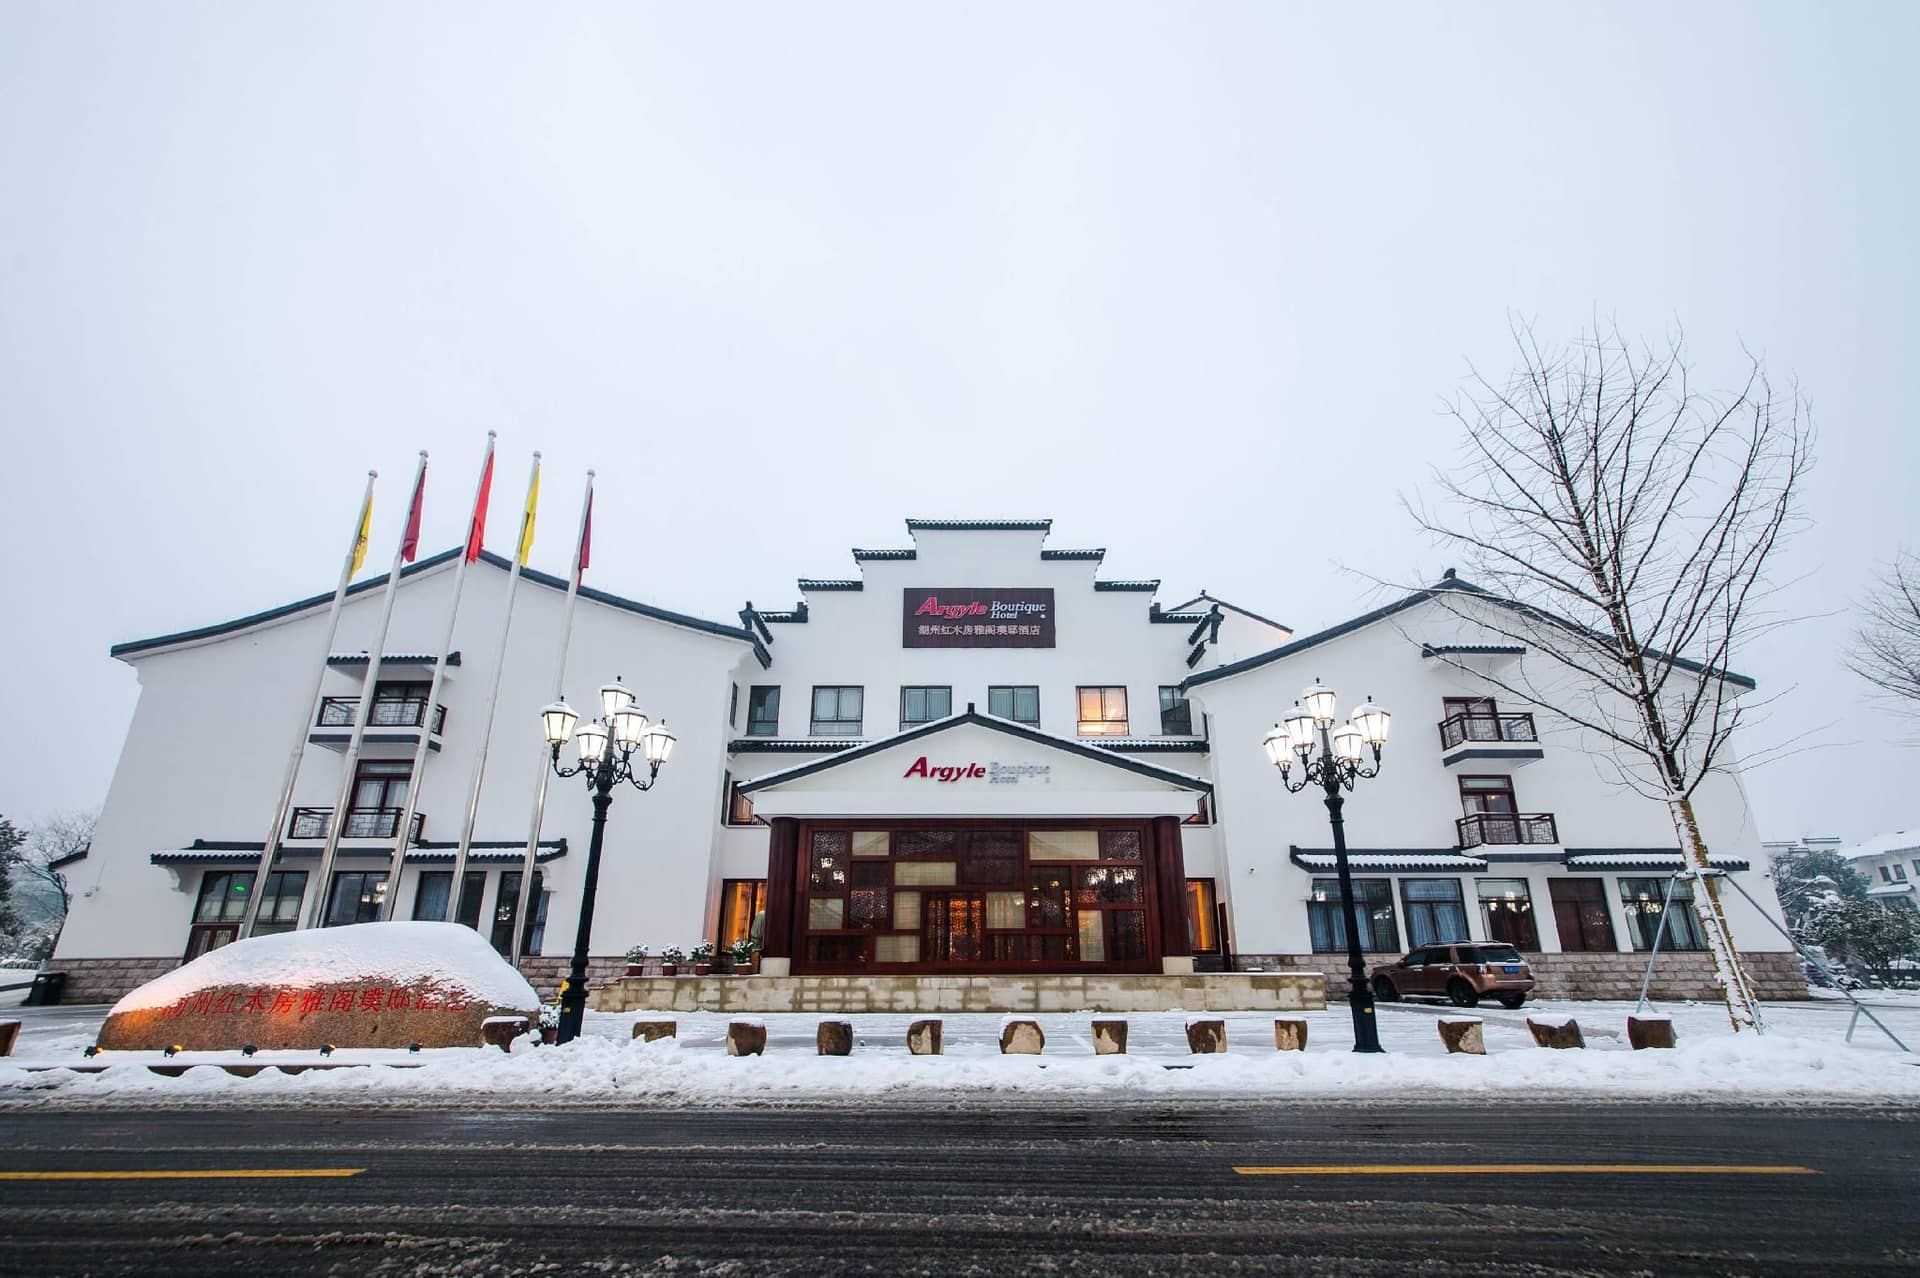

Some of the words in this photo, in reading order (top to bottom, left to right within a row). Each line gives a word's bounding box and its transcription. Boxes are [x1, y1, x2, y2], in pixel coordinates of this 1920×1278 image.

[915, 596, 988, 619] Argyle
[990, 601, 1046, 614] Boutique
[990, 611, 1018, 619] Hotel
[903, 756, 986, 782] Argyle
